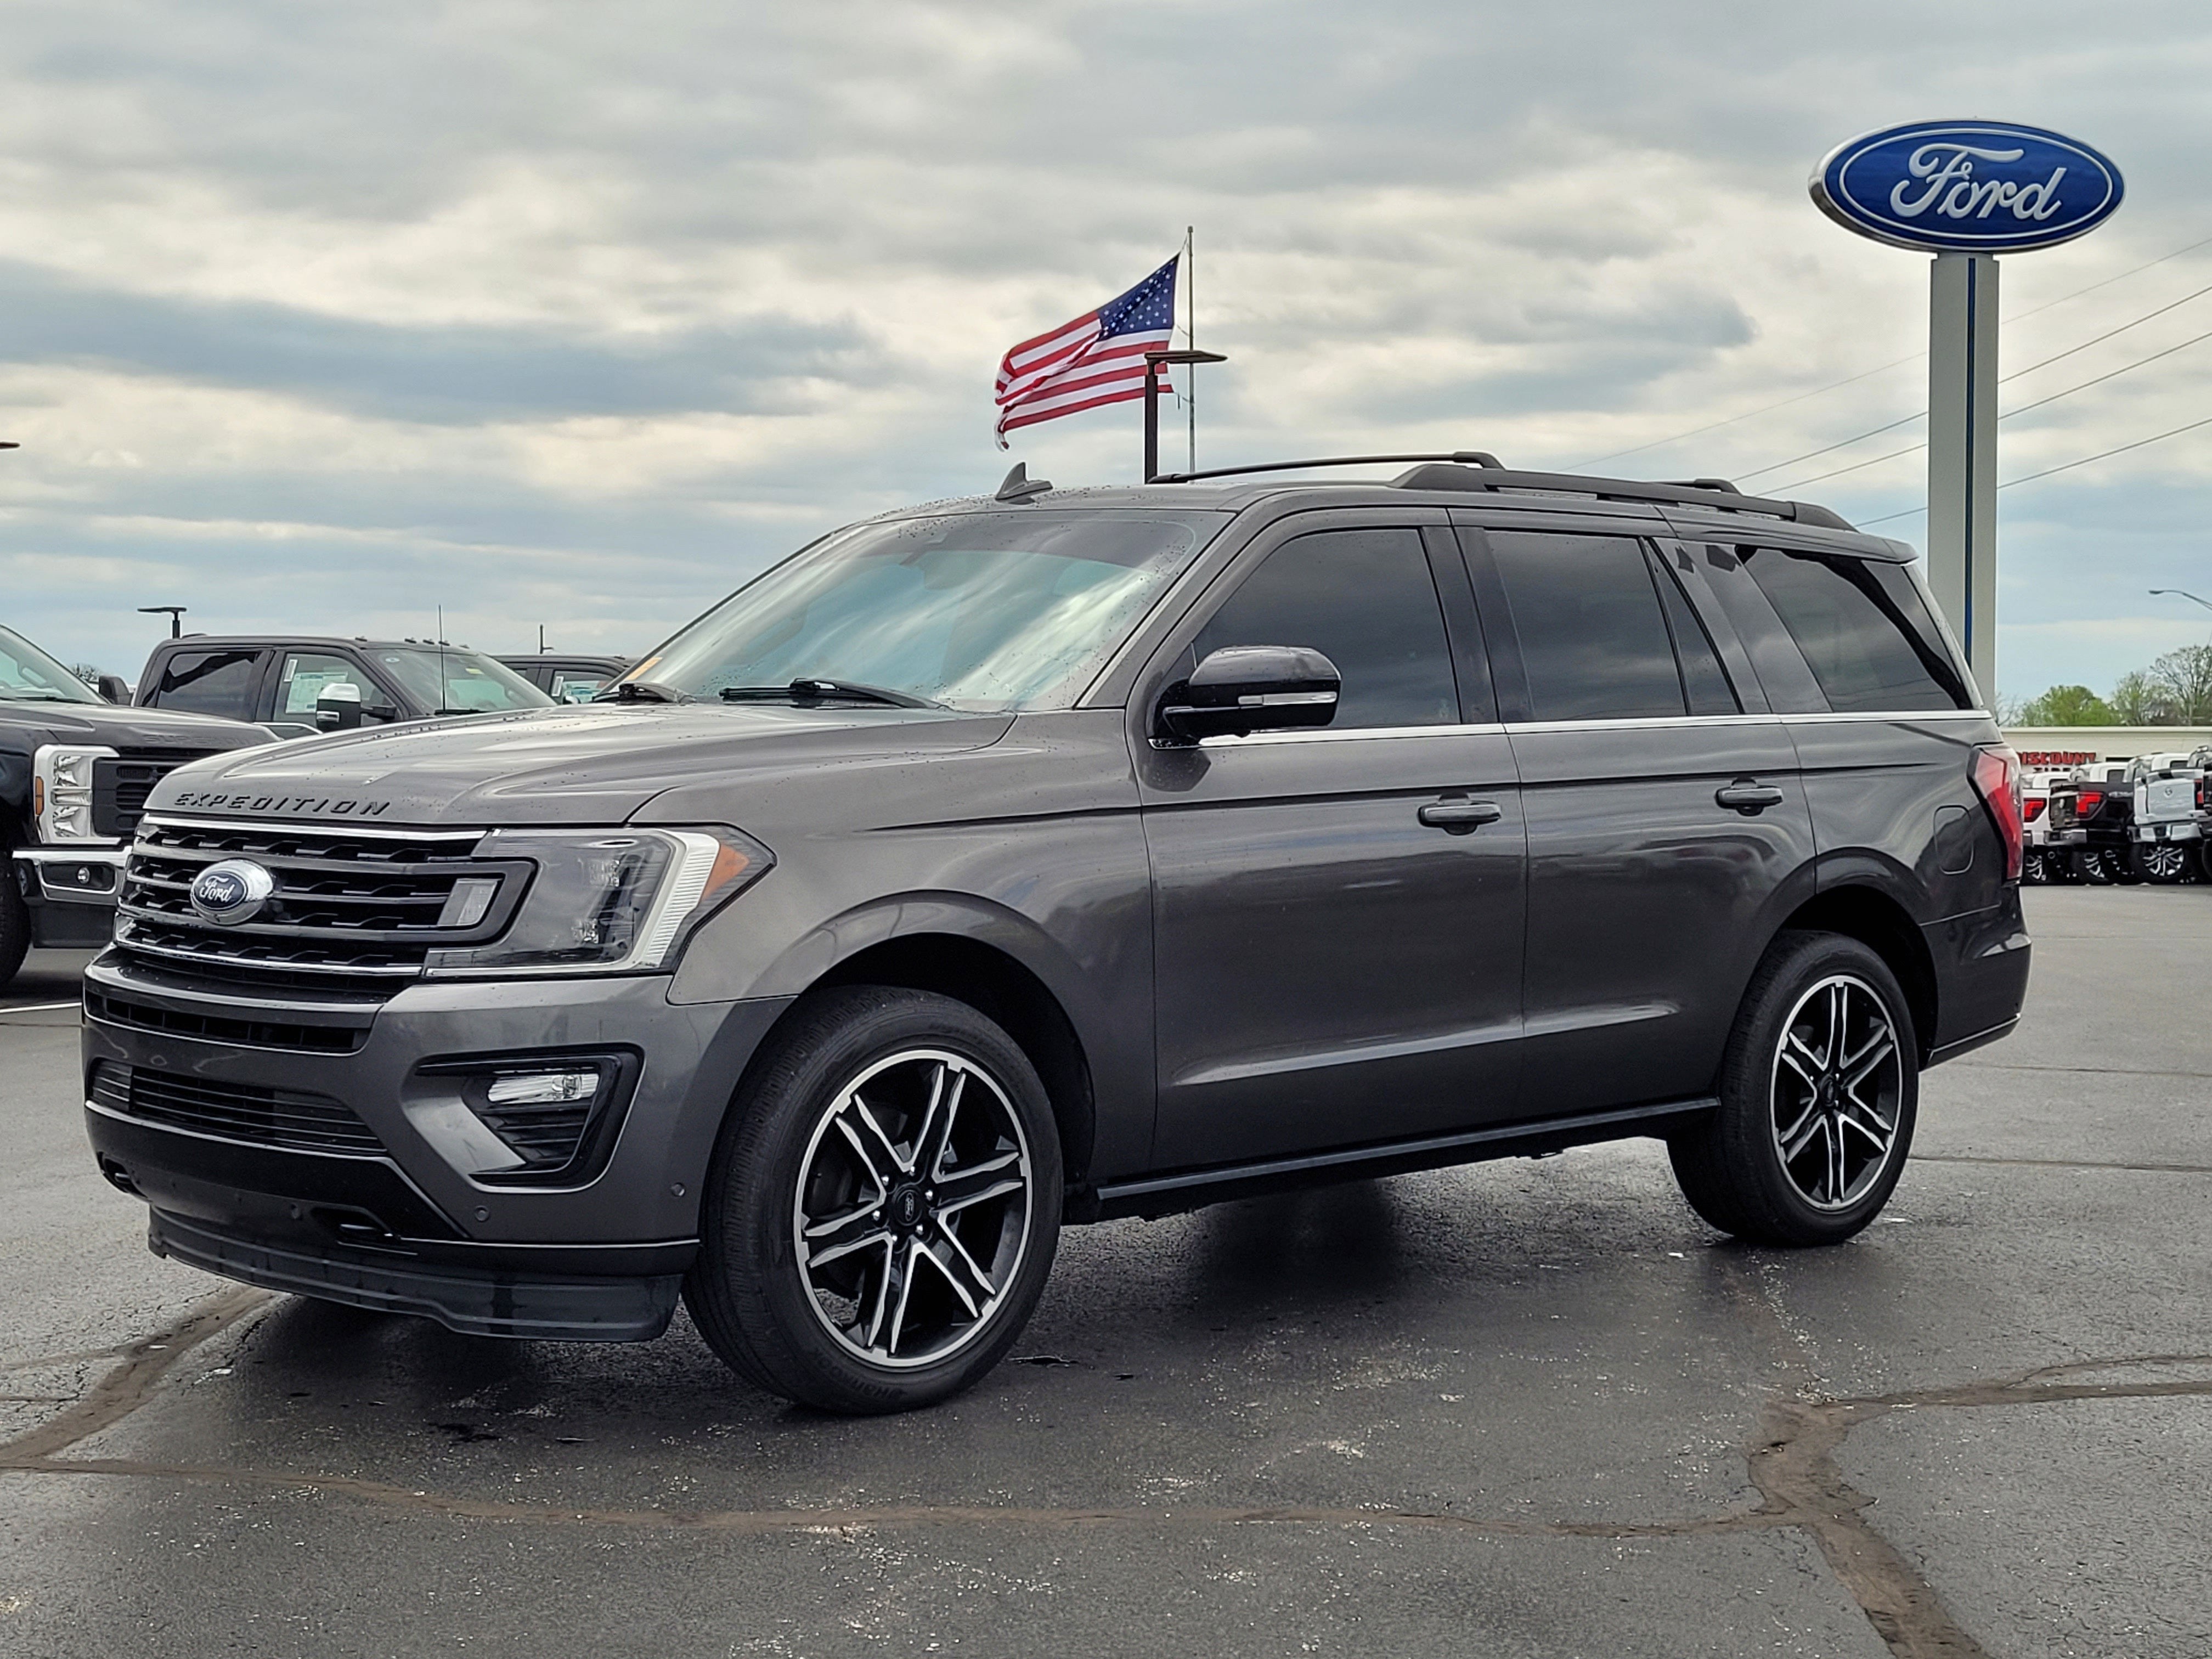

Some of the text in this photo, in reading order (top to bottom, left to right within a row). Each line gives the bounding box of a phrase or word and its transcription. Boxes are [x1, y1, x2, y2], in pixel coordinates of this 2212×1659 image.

[1890, 143, 2067, 221] Ford
[174, 793, 391, 816] EXPEDITION
[199, 875, 235, 902] Ford
